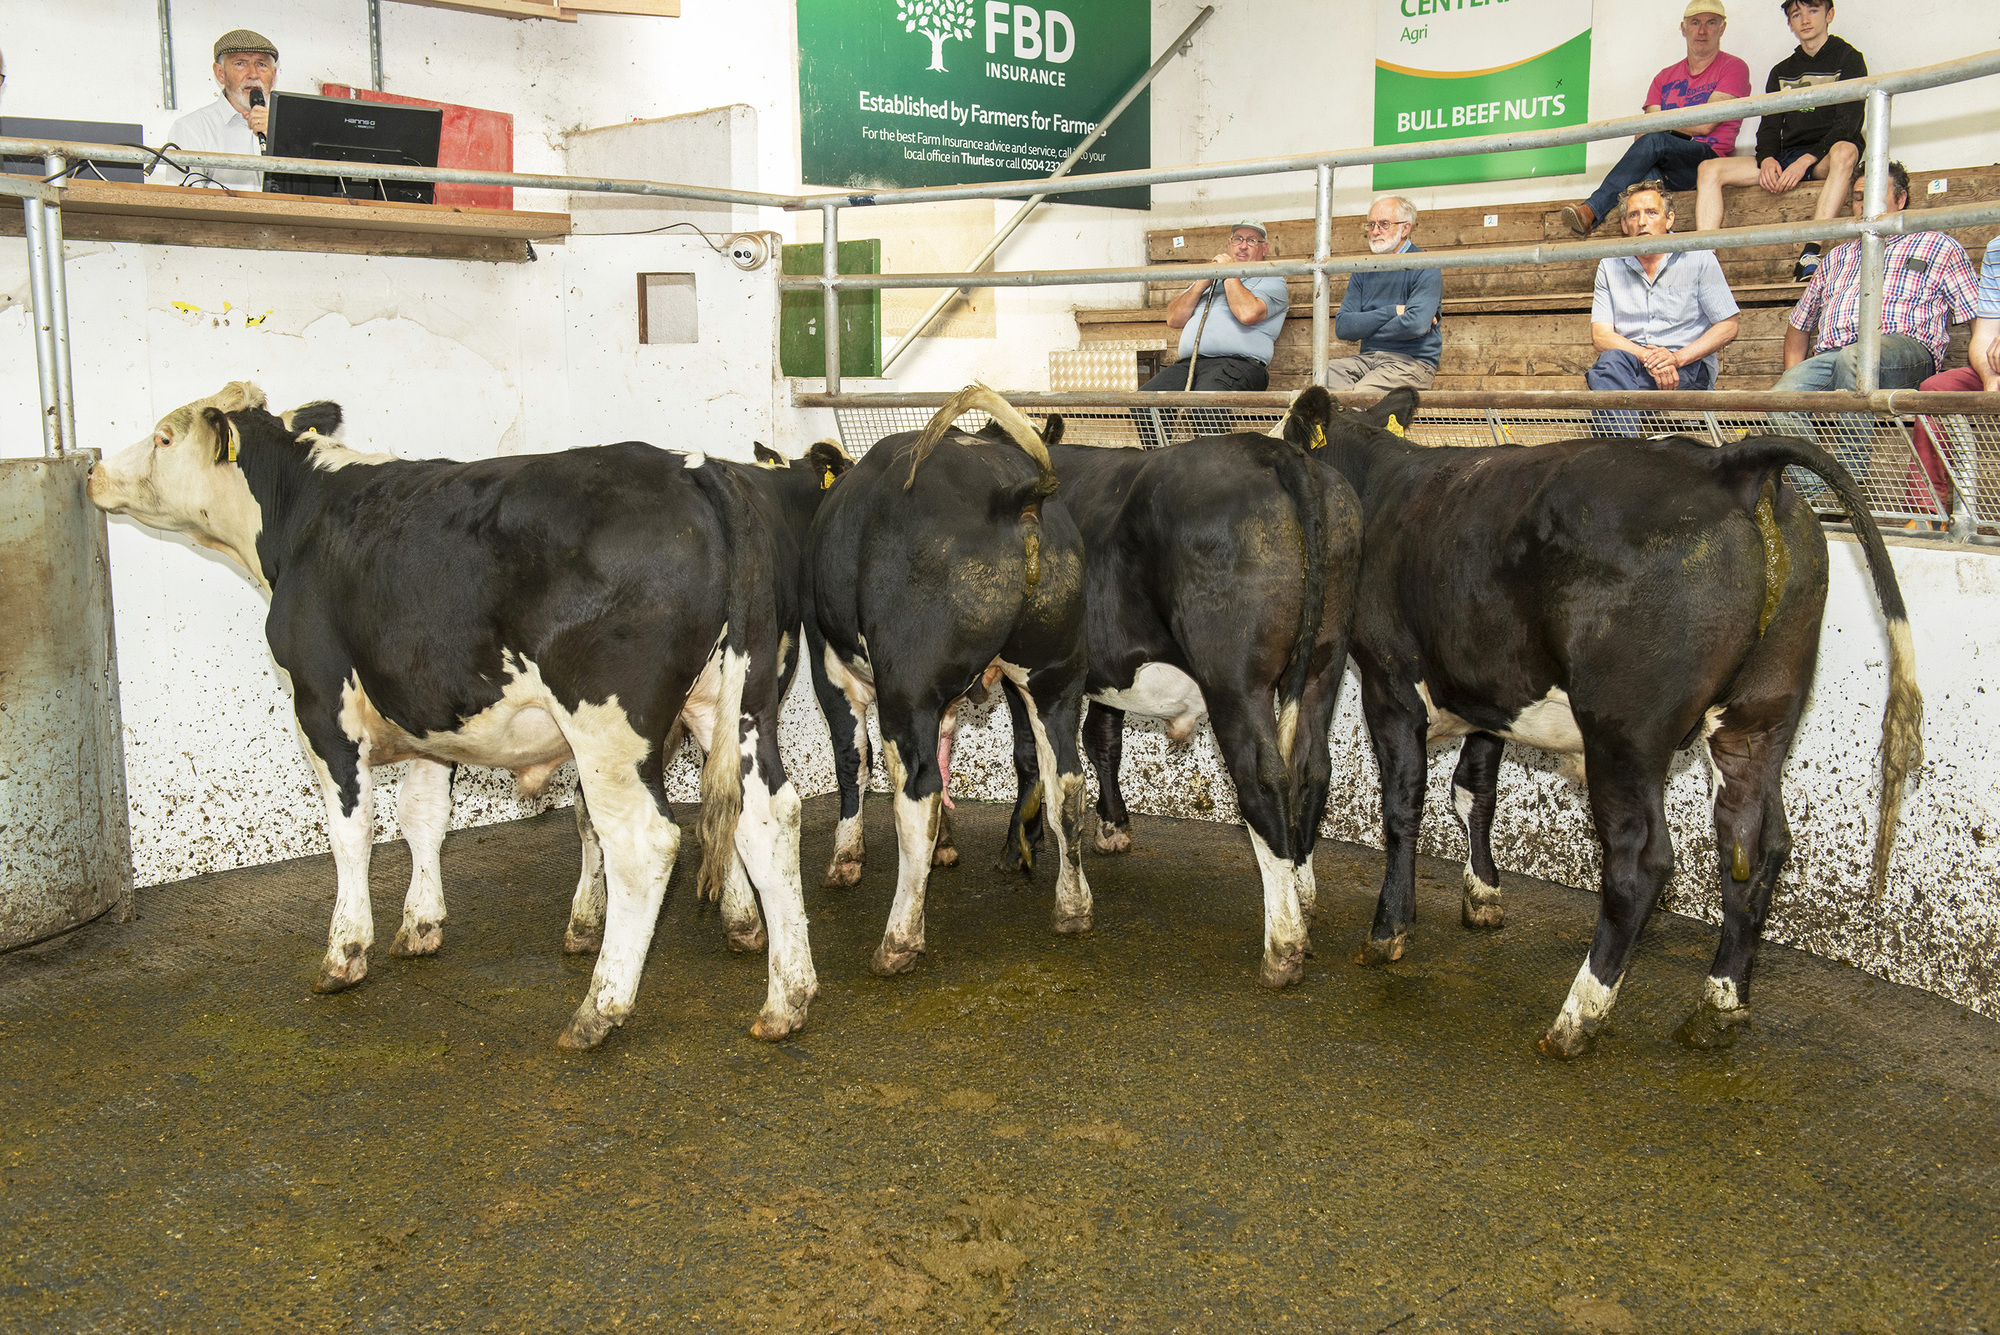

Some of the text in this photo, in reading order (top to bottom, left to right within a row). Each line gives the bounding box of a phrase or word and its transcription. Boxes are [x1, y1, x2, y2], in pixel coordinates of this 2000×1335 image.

[985, 0, 1075, 64] FBD
[1400, 24, 1428, 44] Agri
[986, 61, 1066, 87] INSURANCE
[859, 90, 948, 120] Established
[951, 100, 969, 127] by
[971, 103, 1029, 129] Farmers
[1031, 110, 1051, 131] for
[1397, 94, 1566, 133] BULL BEEF NUTS
[862, 126, 878, 139] For
[879, 127, 895, 141] the
[896, 129, 916, 144] best
[917, 132, 941, 146] Farm
[942, 134, 984, 150] Insurance
[984, 139, 1011, 152] advice
[1011, 143, 1027, 155] and
[1028, 145, 1057, 159] service,
[1058, 147, 1072, 158] call
[1088, 152, 1107, 163] your
[904, 146, 926, 161] local
[926, 149, 951, 163] office
[951, 151, 960, 164] in
[960, 152, 995, 167] Thurles
[995, 158, 1005, 168] or
[1005, 157, 1020, 170] call
[1021, 158, 1044, 171] 0504
[1934, 180, 1941, 190] 3
[1487, 215, 1494, 225] 2
